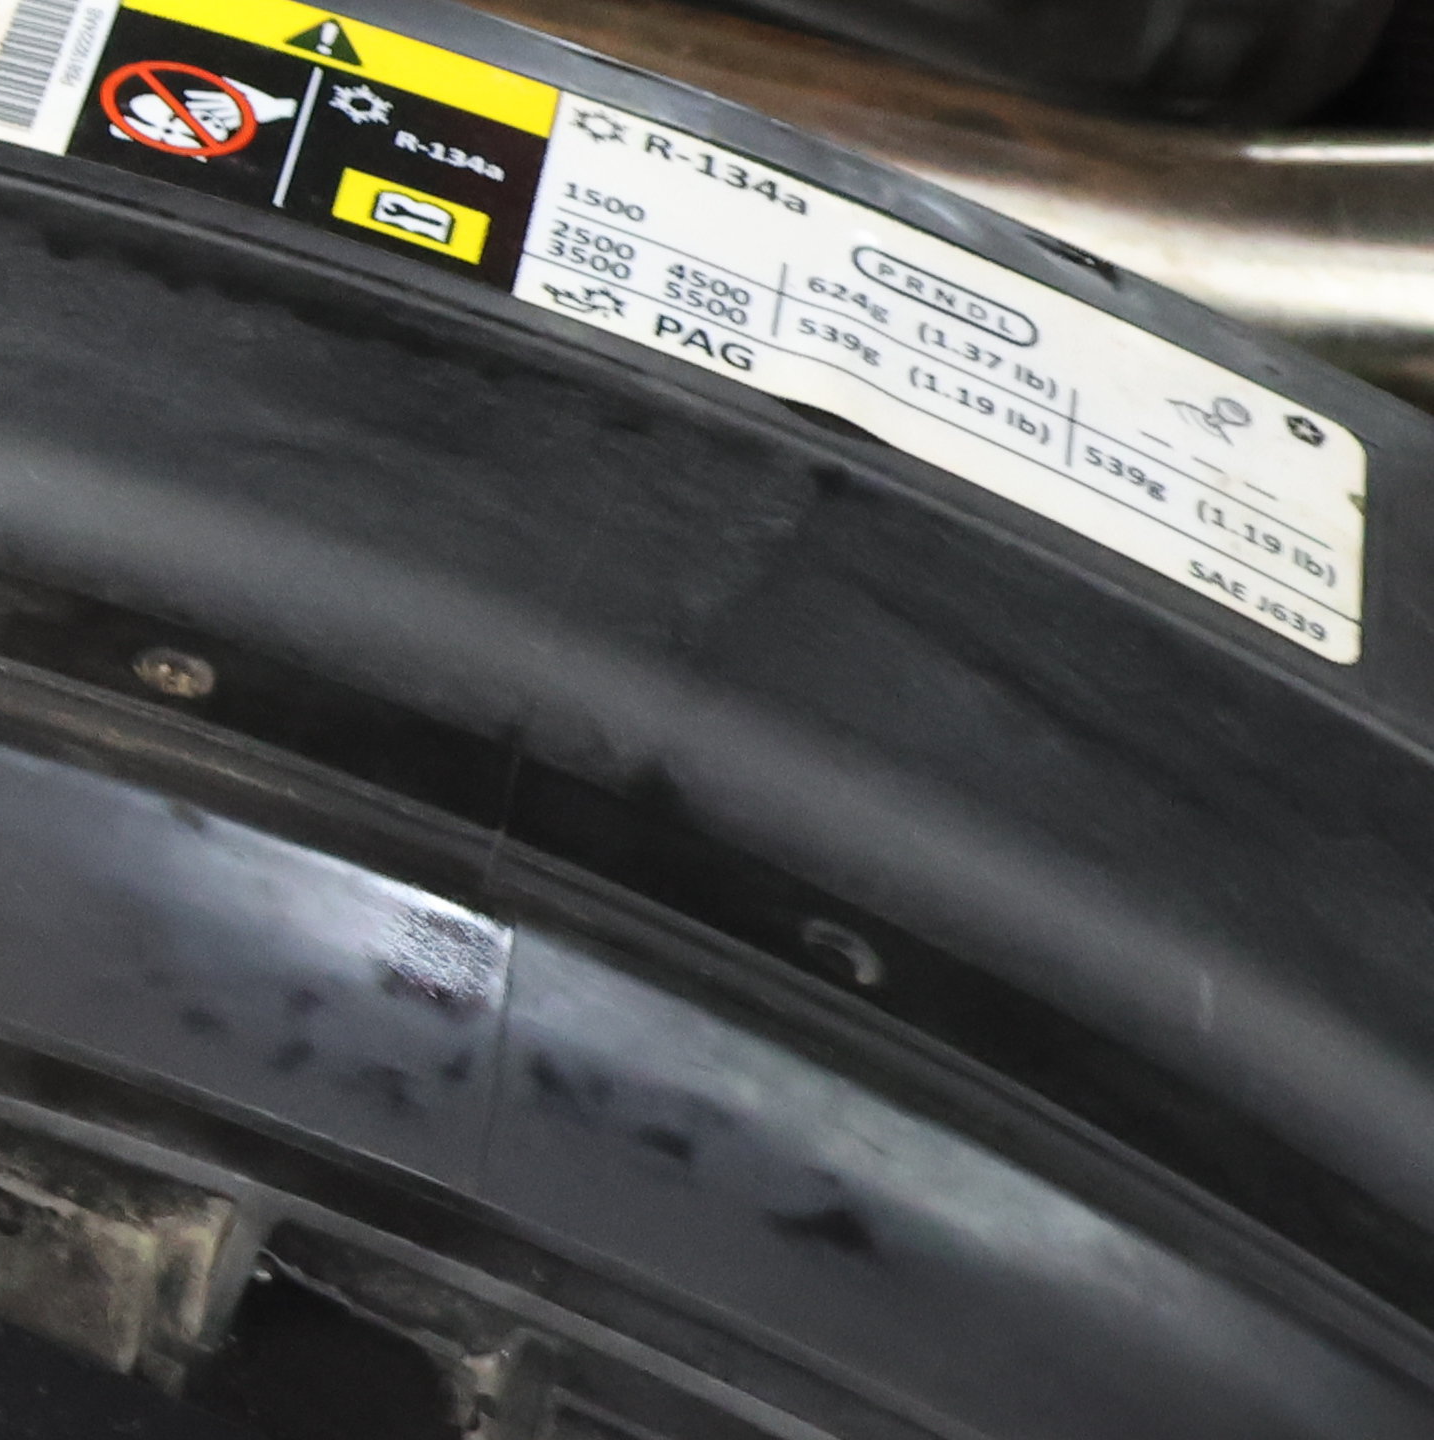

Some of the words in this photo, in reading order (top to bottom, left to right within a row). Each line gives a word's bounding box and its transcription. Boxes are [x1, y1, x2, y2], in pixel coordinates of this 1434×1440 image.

[394, 129, 506, 183] R-134a
[642, 130, 809, 217] R-134a
[563, 181, 646, 223] 1500
[546, 240, 632, 281] 3500
[549, 219, 636, 262] 2500
[663, 281, 749, 327] 5500
[665, 262, 752, 308] 4500
[653, 313, 757, 373] PAG
[807, 276, 891, 325] 624g
[917, 321, 1003, 370] (1.37
[1012, 362, 1060, 400] lb)
[797, 317, 881, 368] 539g
[907, 365, 996, 416] (1.19
[1005, 407, 1052, 445] lb)
[1085, 444, 1169, 504] 539g
[1197, 499, 1284, 556] (1.19
[1293, 544, 1338, 588] lb)
[1187, 558, 1250, 604] SAE
[1255, 595, 1328, 642] J639
